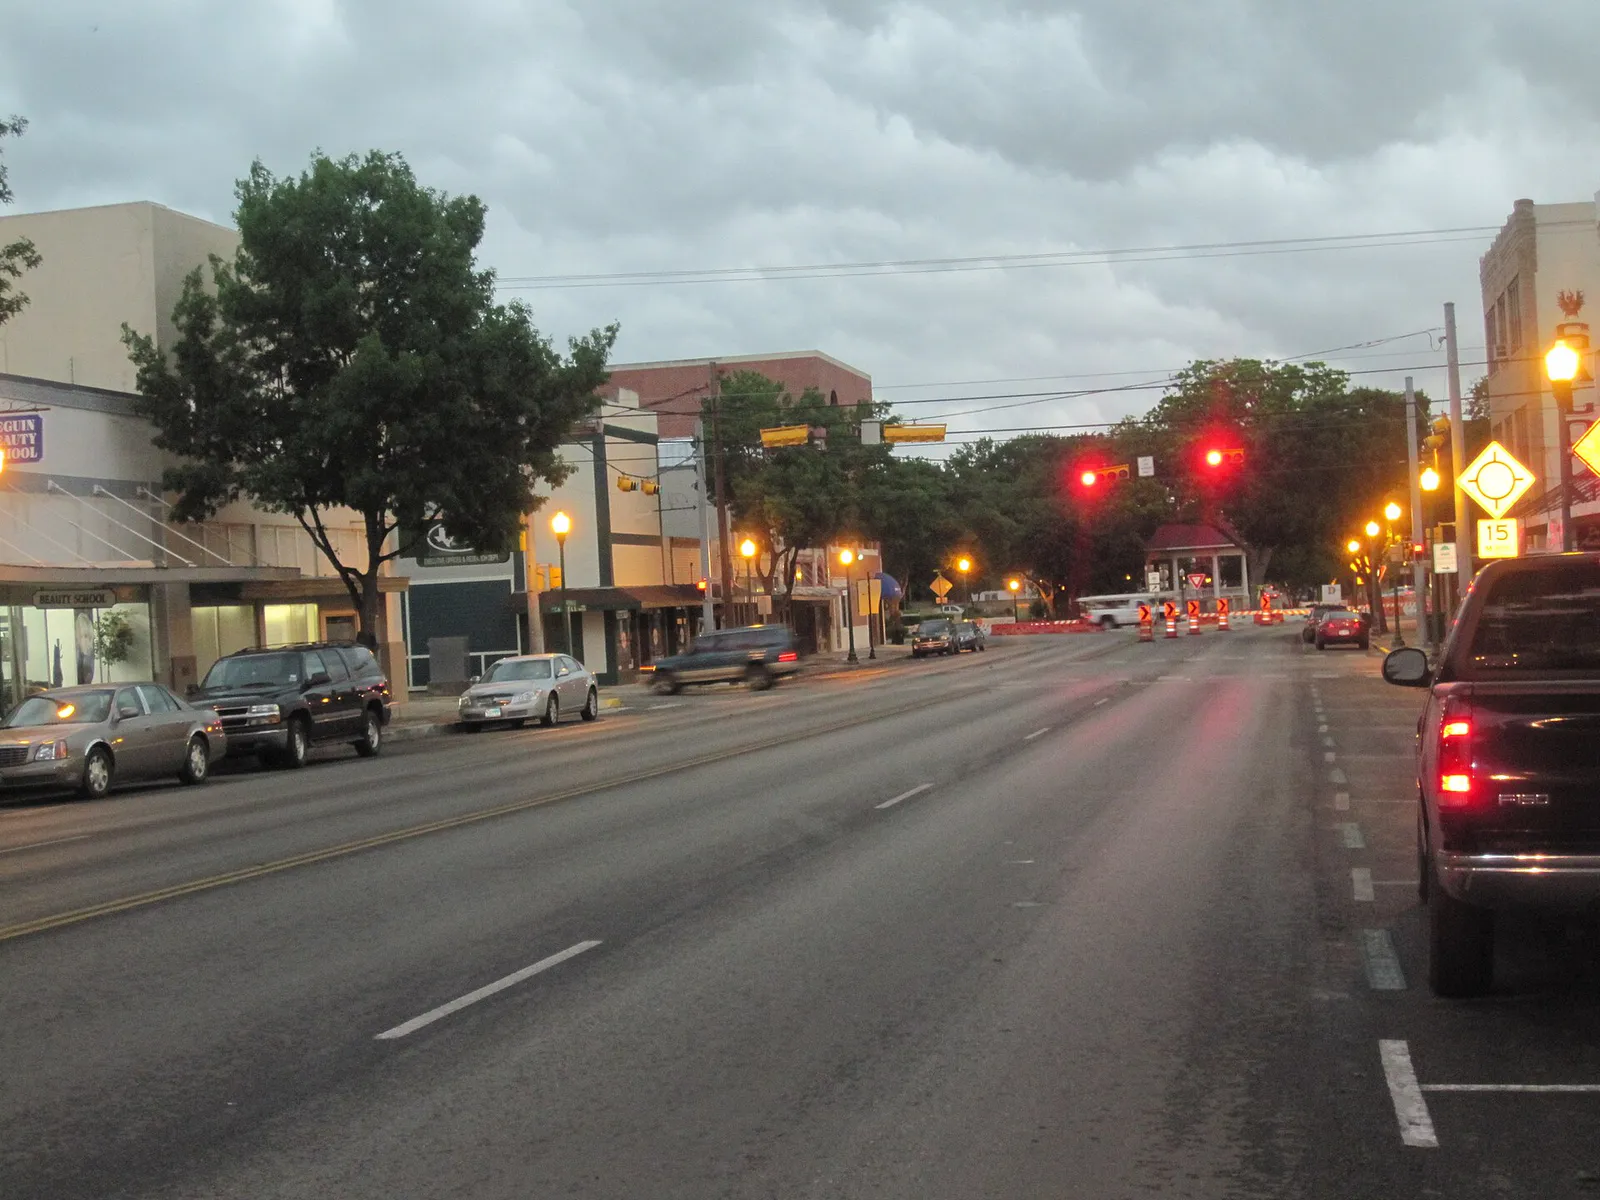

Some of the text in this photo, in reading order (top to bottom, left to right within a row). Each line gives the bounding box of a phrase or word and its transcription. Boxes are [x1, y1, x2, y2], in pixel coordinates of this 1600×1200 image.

[1487, 525, 1508, 541] 15
[39, 593, 107, 604] BEAUTY SCHOOL
